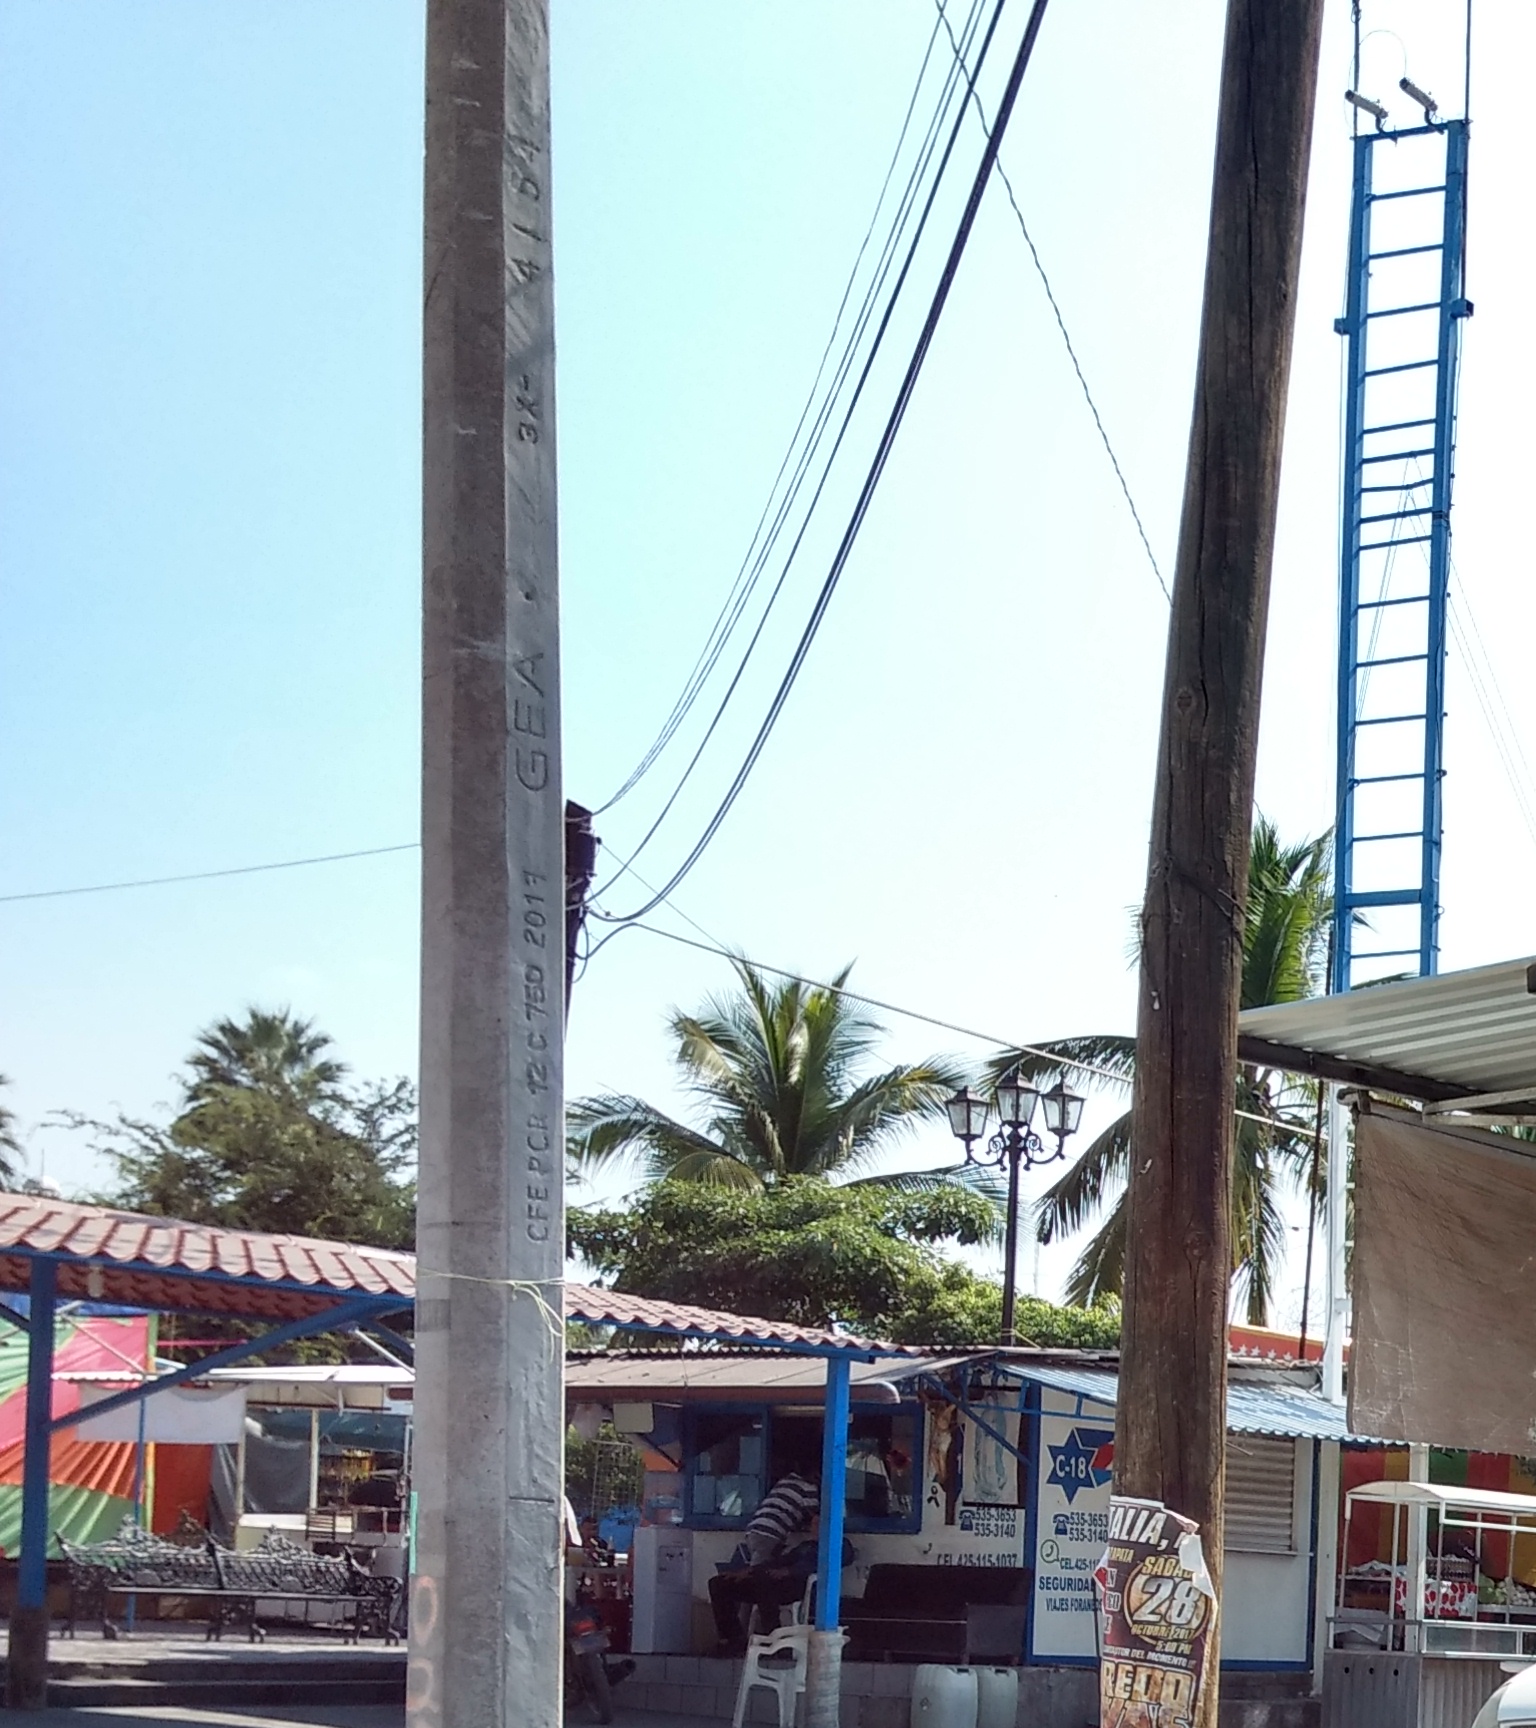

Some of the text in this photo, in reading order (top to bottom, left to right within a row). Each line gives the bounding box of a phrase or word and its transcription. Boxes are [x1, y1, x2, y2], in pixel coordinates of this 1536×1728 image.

[1055, 1454, 1087, 1479] C-18
[974, 1522, 1016, 1538] 535-3140
[1068, 1527, 1109, 1544] 535-3140
[1132, 1575, 1201, 1625] 28
